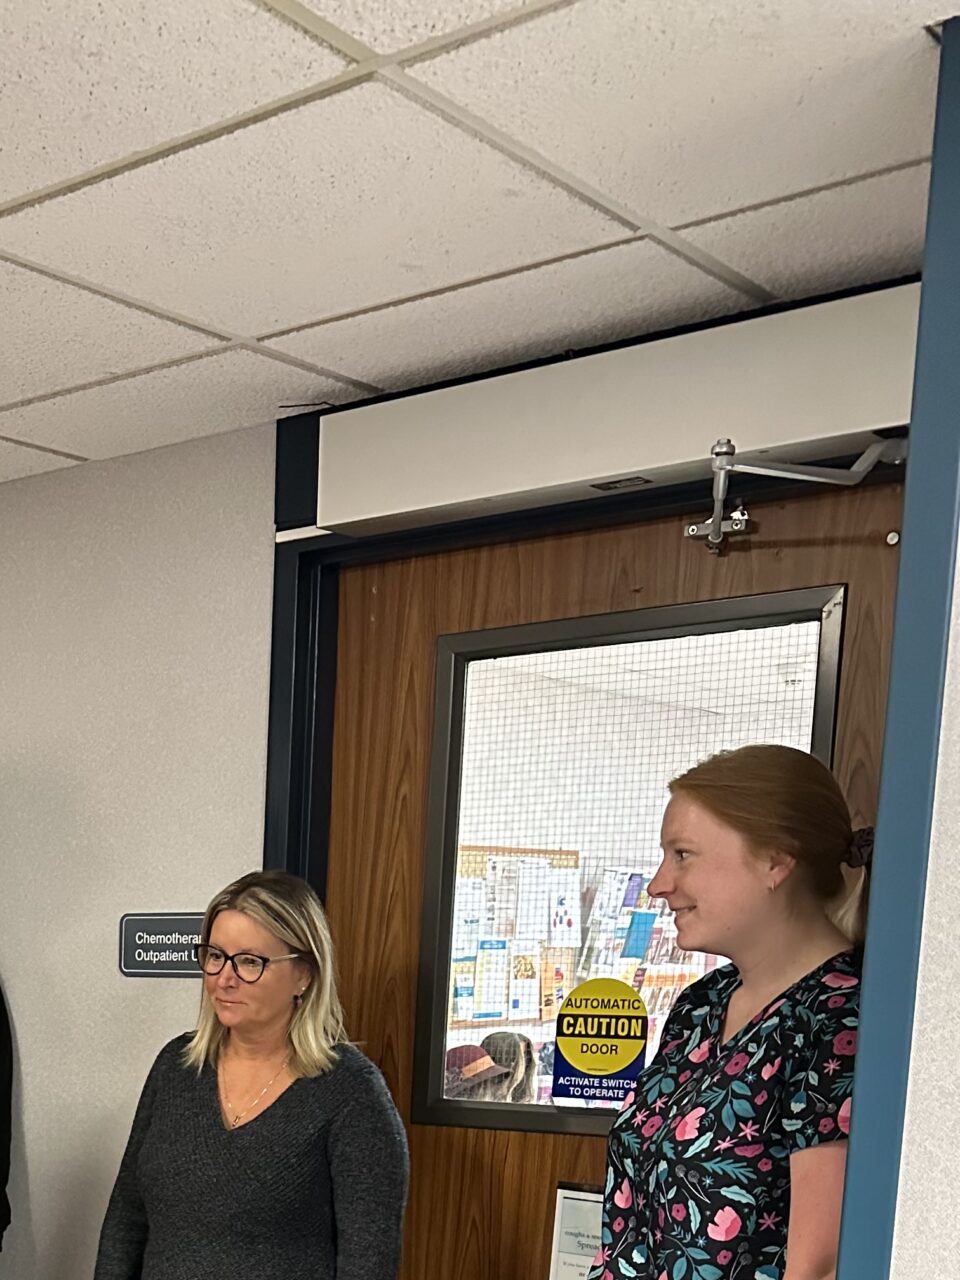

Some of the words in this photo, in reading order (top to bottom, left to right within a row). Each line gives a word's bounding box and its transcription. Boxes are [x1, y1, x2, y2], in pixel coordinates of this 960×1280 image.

[135, 949, 189, 964] Outpatient
[566, 998, 641, 1010] AUTOMATIC
[562, 1016, 642, 1036] CAUTION
[581, 1043, 618, 1055] DOOR
[558, 1077, 600, 1088] ACTIVATE
[569, 1087, 581, 1096] TO
[583, 1089, 625, 1098] OPERATE
